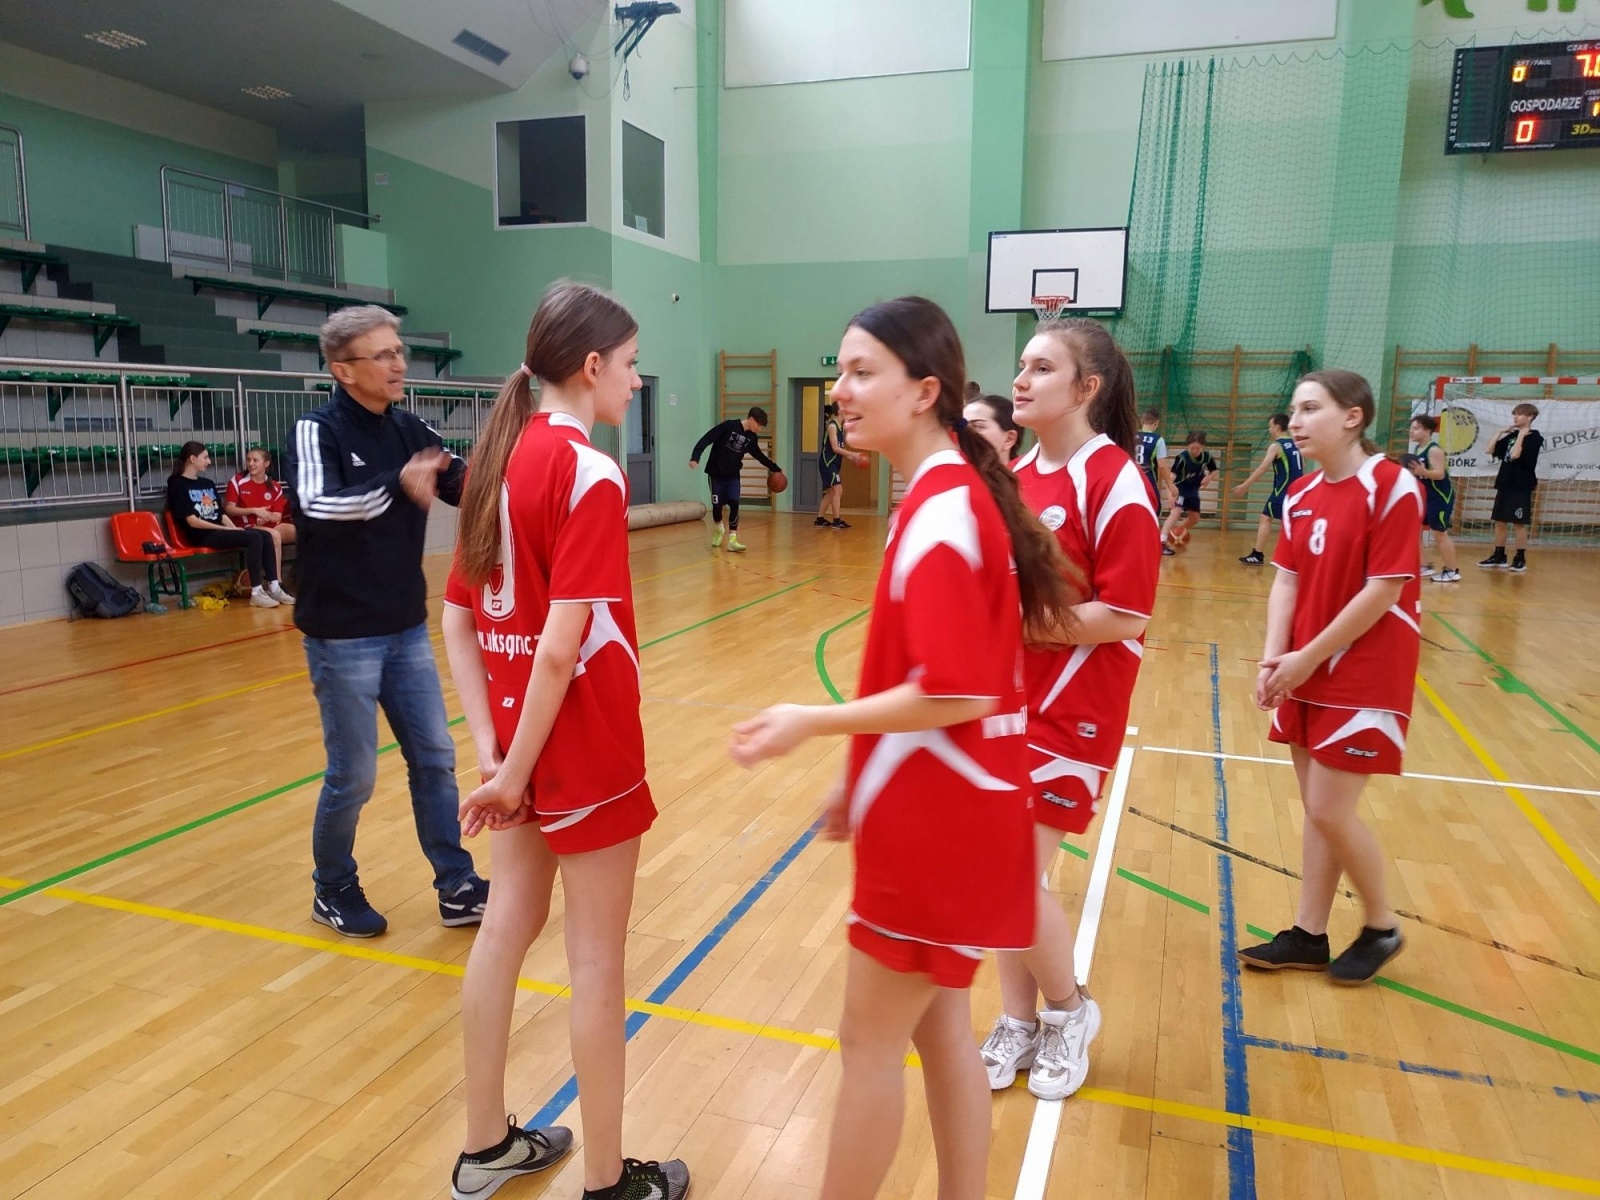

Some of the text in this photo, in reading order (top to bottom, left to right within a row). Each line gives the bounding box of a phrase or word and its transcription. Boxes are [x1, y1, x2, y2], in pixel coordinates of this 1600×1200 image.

[1512, 66, 1527, 82] 0
[1511, 97, 1582, 113] GOSPODARZE
[1516, 120, 1534, 143] 0
[1143, 435, 1153, 444] 13
[1309, 518, 1328, 555] 8
